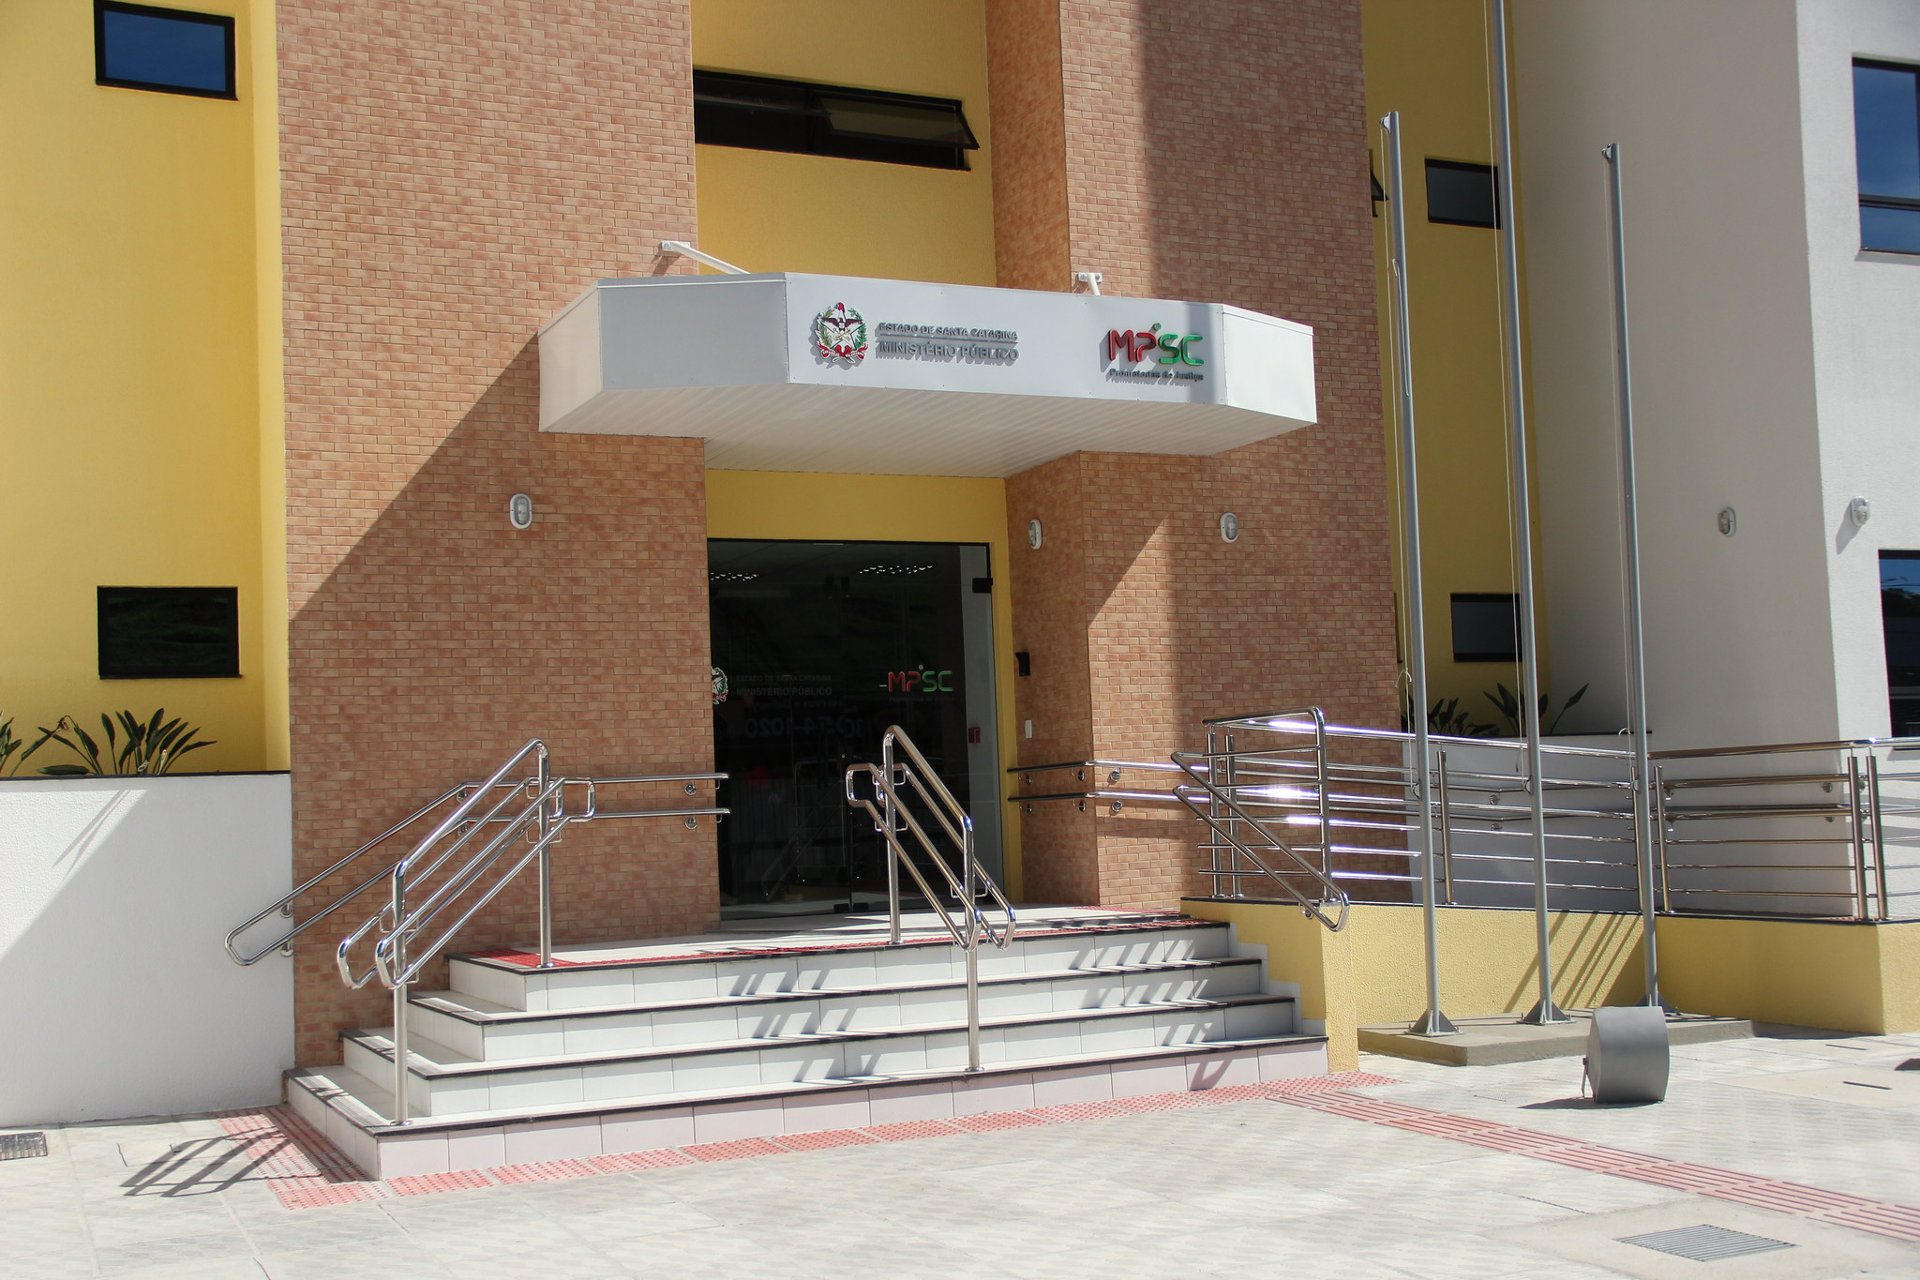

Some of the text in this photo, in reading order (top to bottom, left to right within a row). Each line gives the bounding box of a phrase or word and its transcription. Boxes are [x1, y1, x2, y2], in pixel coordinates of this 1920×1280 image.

[879, 322, 1018, 340] ESTADO DE SANTA CATARINA
[880, 340, 1019, 361] MINISTÉRIO PÚBLICO
[1108, 323, 1205, 366] MPSC
[1162, 370, 1175, 379] de
[887, 664, 955, 693] MPSC
